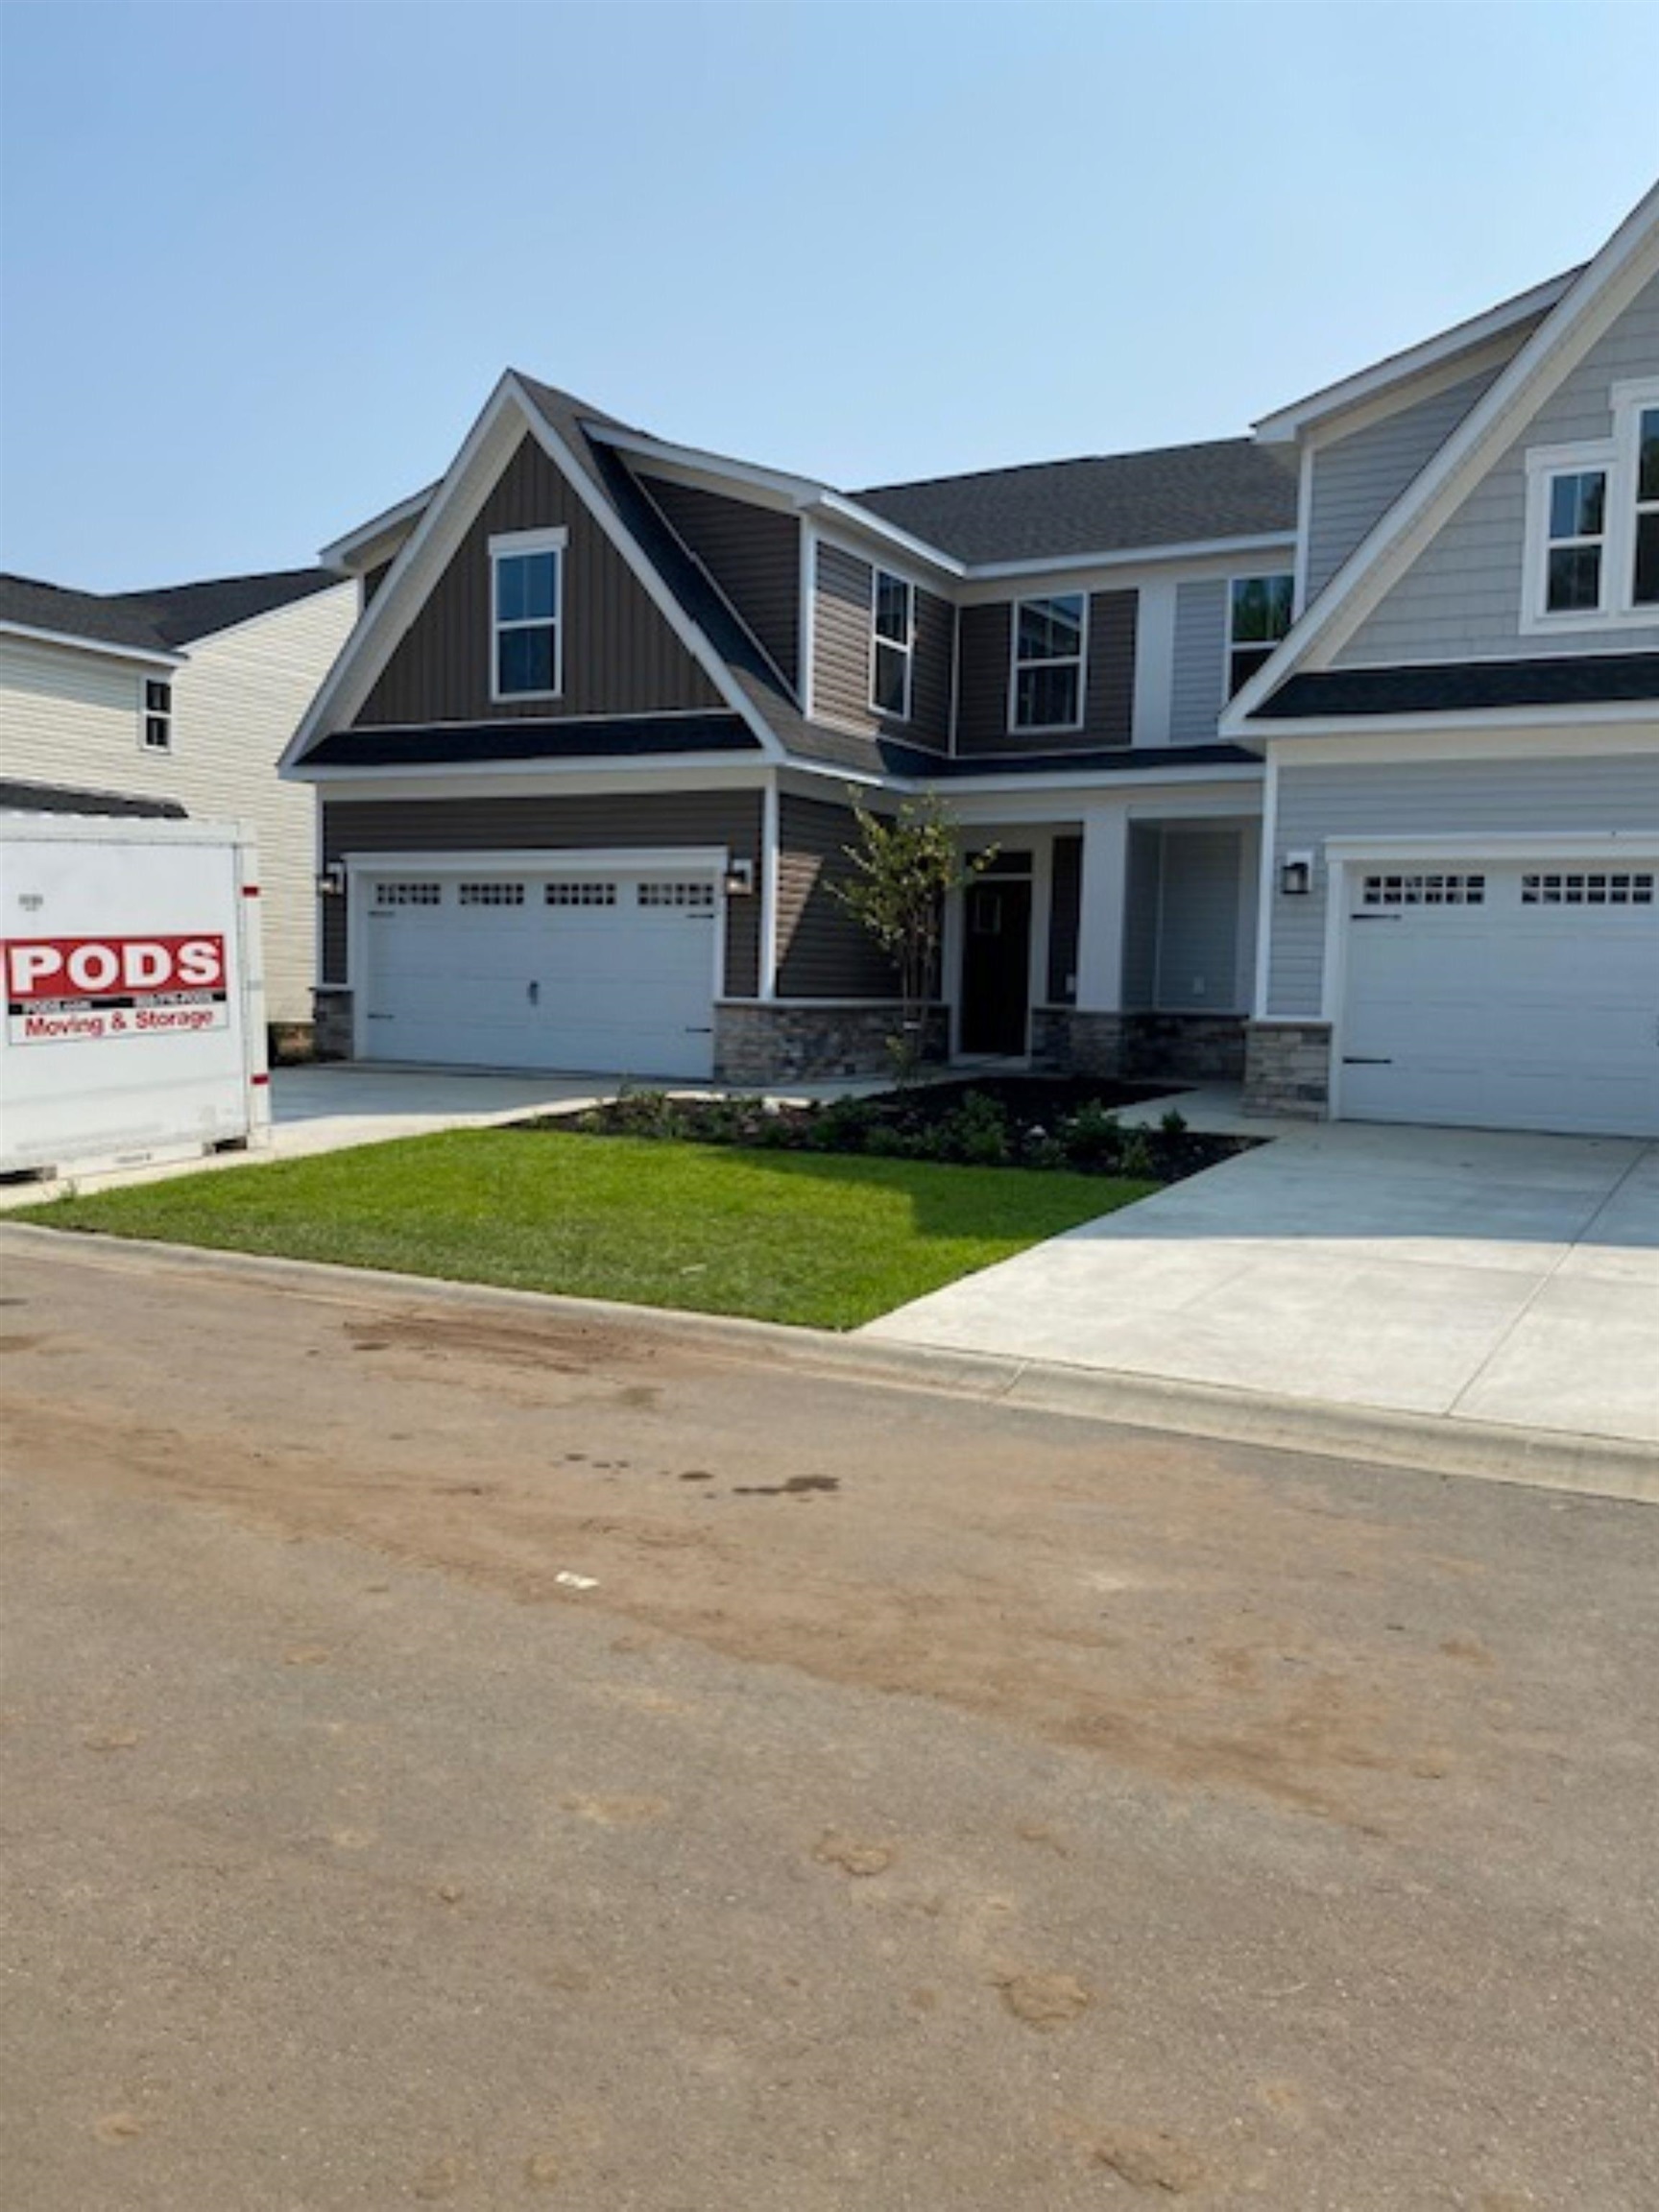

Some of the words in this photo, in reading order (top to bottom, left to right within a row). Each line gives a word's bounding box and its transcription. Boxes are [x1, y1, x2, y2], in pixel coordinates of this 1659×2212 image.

[11, 941, 221, 993] PODS
[25, 1014, 104, 1038] Moving
[110, 1011, 127, 1030] &
[135, 1007, 213, 1031] Storage
